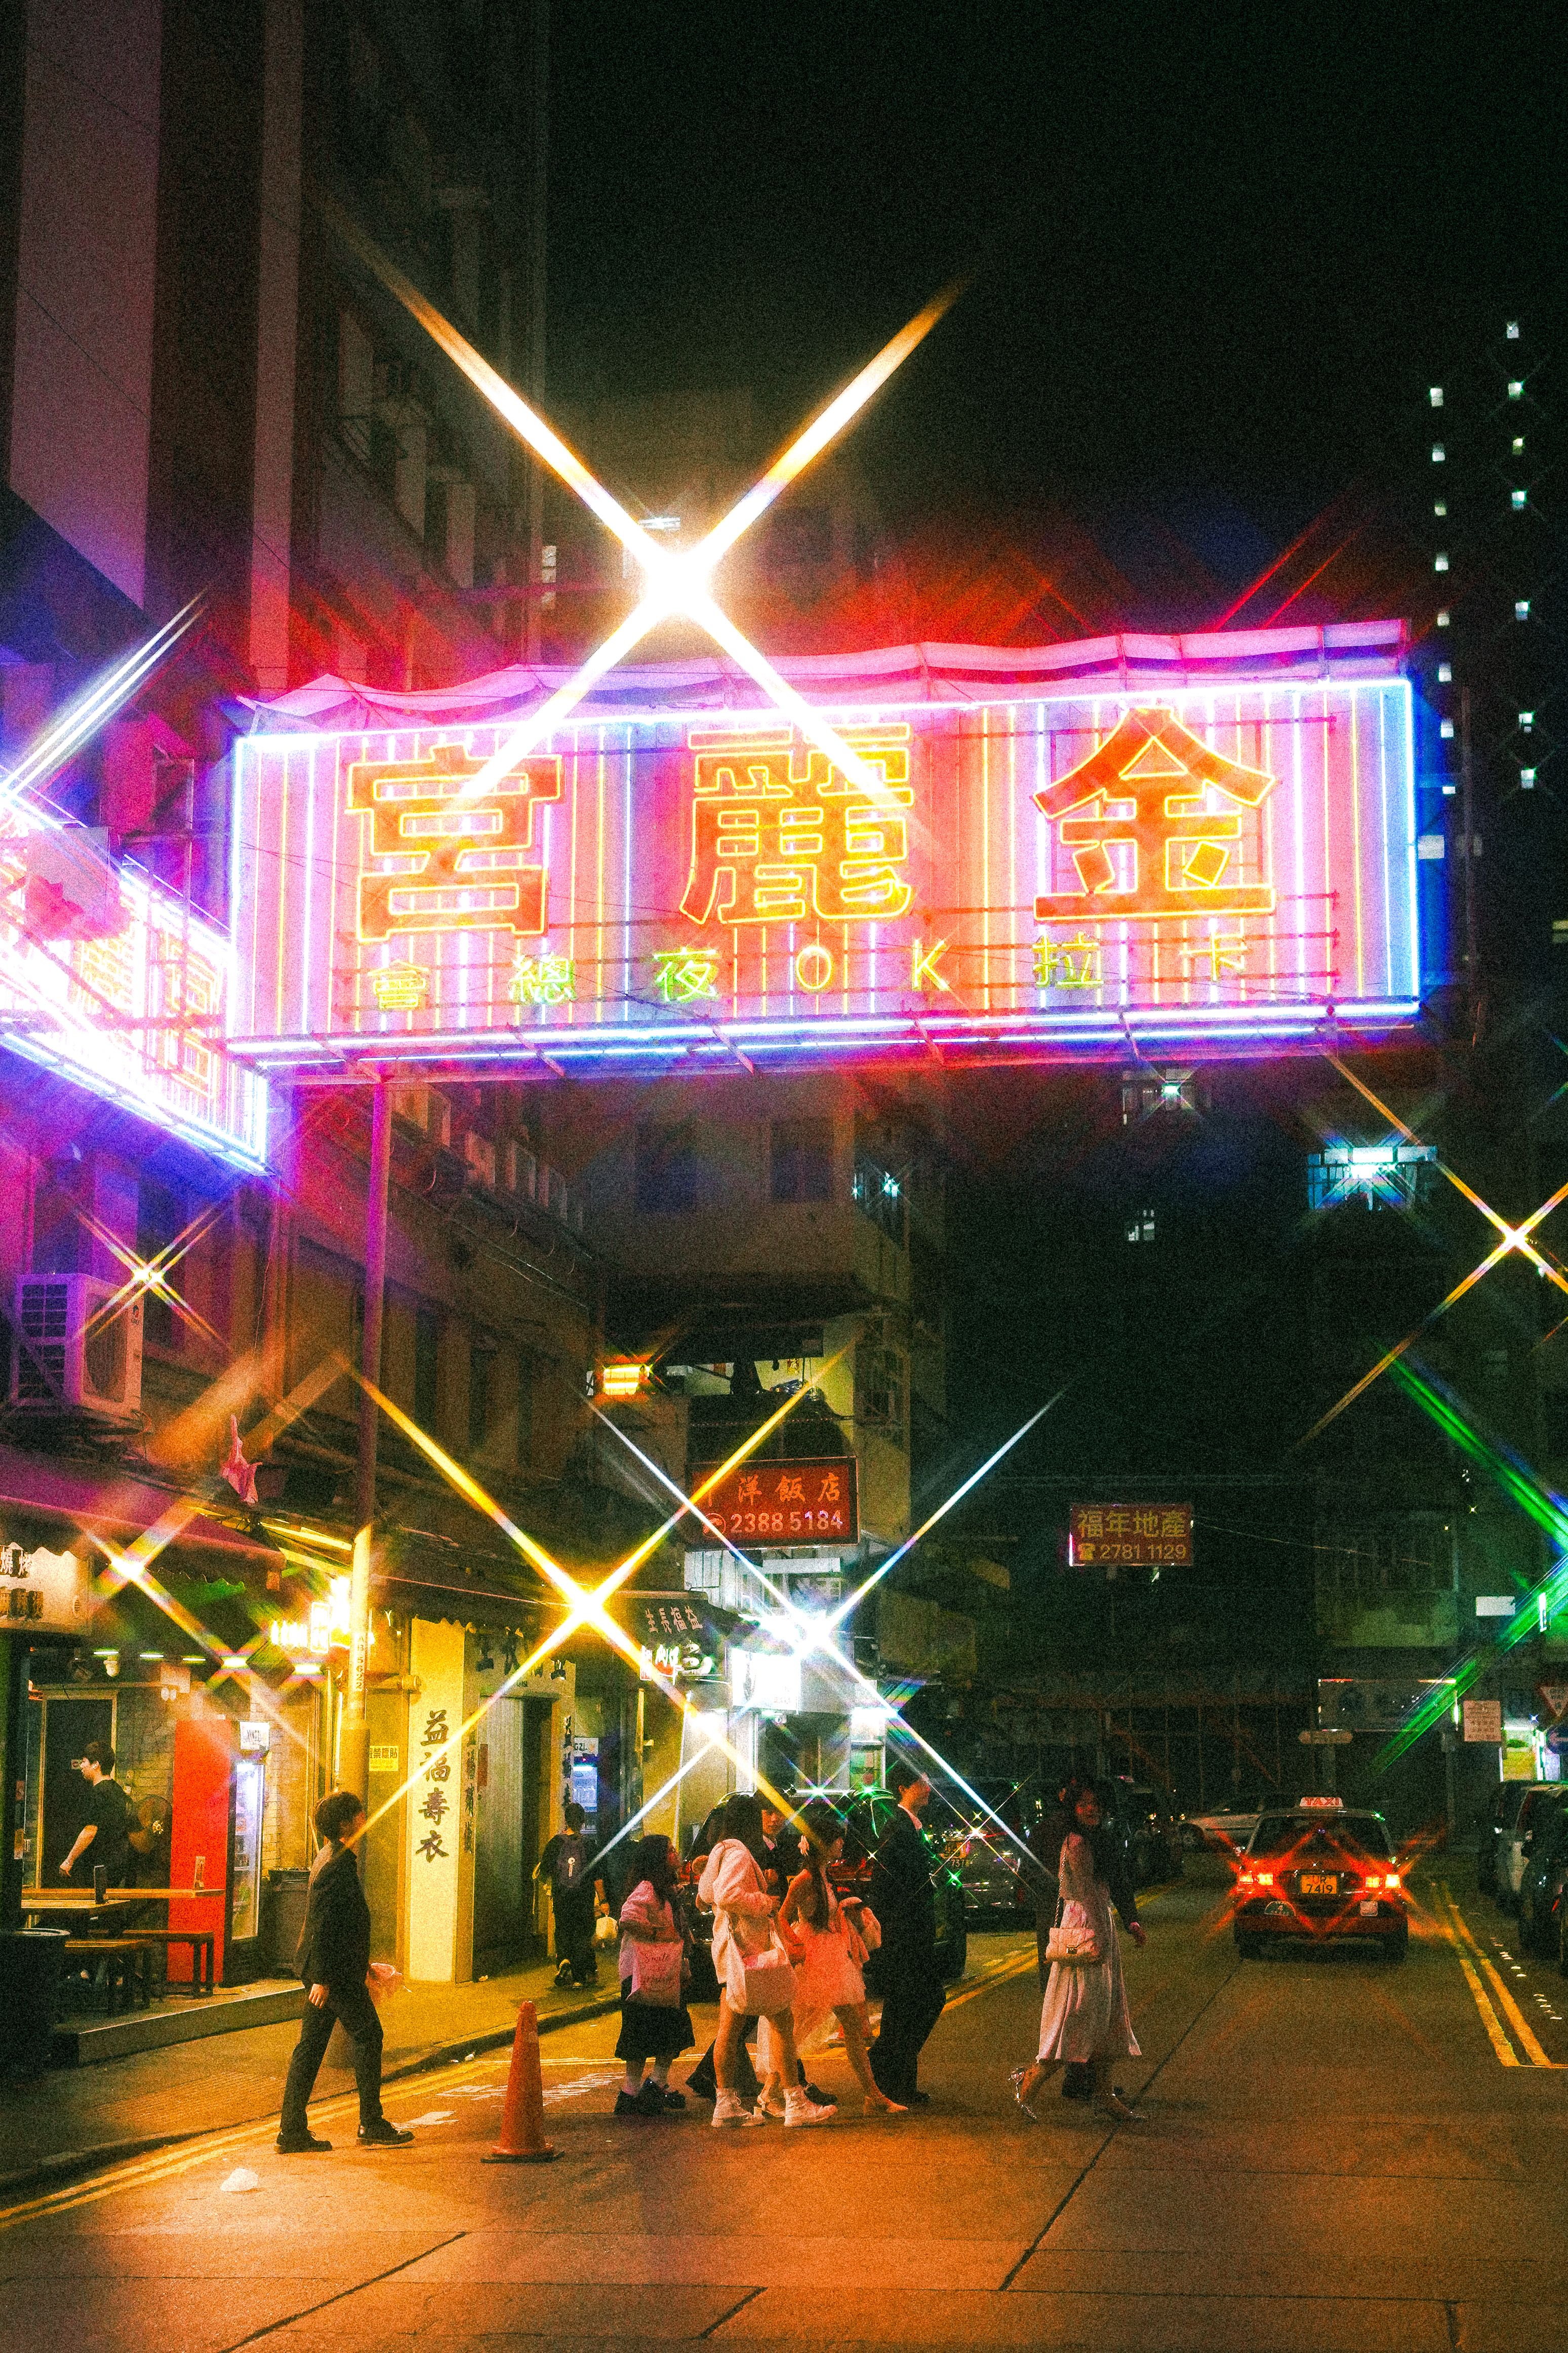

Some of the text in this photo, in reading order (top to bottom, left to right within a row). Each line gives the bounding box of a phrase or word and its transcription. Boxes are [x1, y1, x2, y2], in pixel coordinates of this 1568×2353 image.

[700, 1472, 841, 1507] 洋飯店
[731, 1510, 843, 1533] 2388 5184
[1078, 1510, 1186, 1538] 福年地產
[1100, 1544, 1187, 1560] 2781 1129
[415, 1709, 451, 1863] 益福壽衣
[1305, 1797, 1339, 1806] TAXI
[1306, 1884, 1333, 1894] 7419
